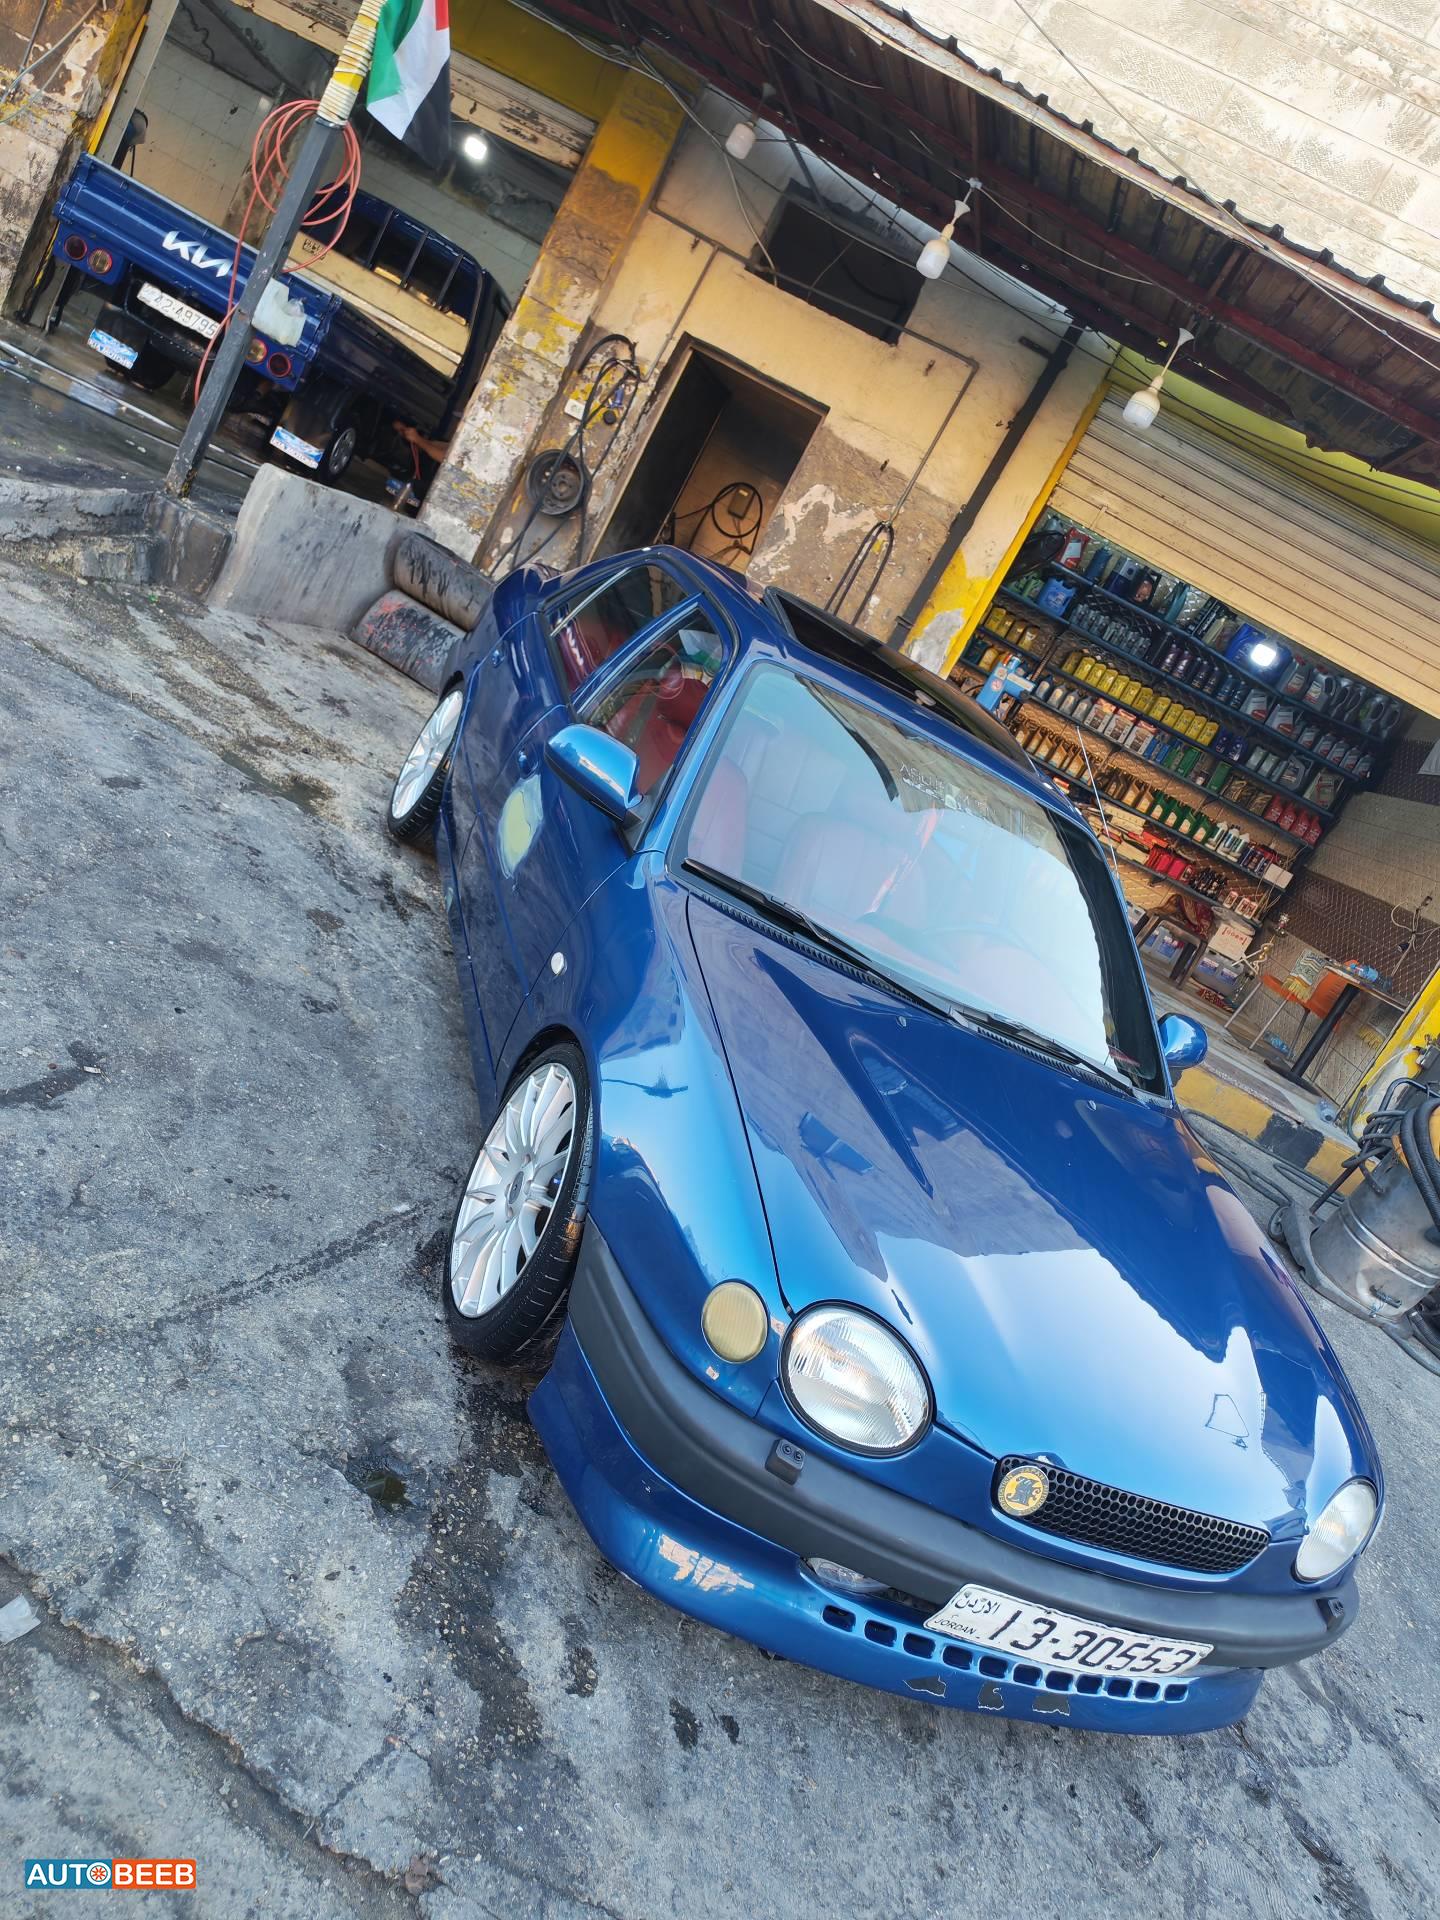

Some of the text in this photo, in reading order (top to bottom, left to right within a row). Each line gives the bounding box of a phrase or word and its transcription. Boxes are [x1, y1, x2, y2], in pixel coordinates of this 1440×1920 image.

[162, 230, 233, 278] KIA
[934, 1619, 977, 1635] JORDAN
[988, 1610, 1197, 1674] 13-30553
